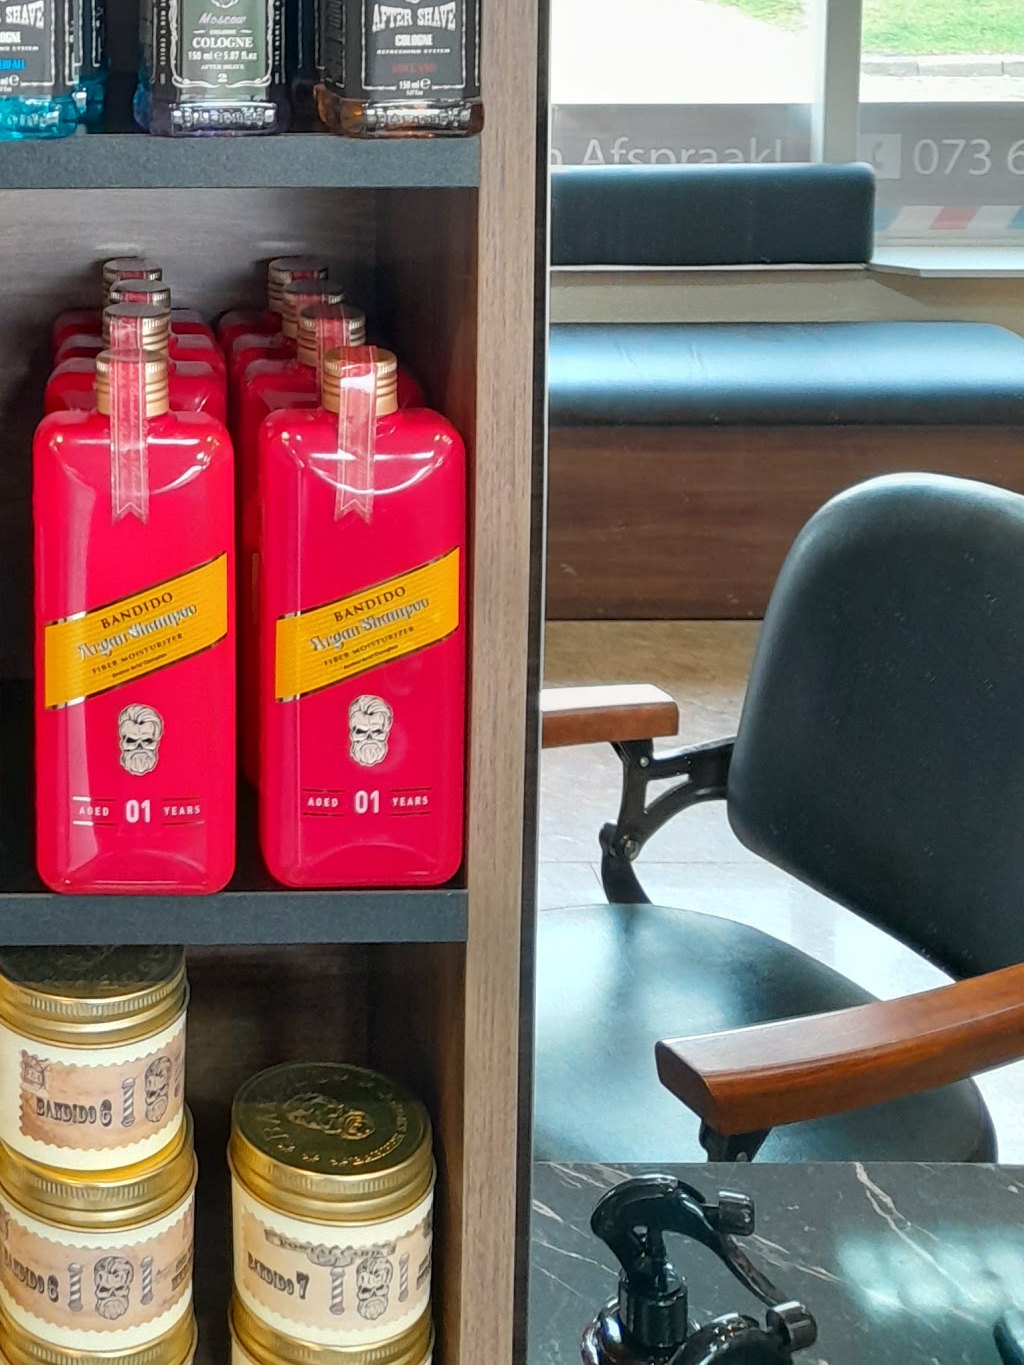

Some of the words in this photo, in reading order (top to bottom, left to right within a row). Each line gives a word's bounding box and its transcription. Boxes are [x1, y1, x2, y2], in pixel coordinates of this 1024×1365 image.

[6, 0, 45, 29] SHAVE
[372, 4, 413, 32] AFTER
[417, 1, 456, 31] SHAVE
[192, 37, 254, 48] COLOGNE
[395, 34, 433, 46] COLOGNE
[203, 51, 213, 60] ml
[217, 73, 228, 83] 2
[399, 80, 411, 90] 150
[913, 138, 992, 176] 073
[101, 592, 173, 629] BANDIDO
[334, 586, 406, 622] BANDIDO
[92, 660, 117, 674] FIBER
[324, 651, 349, 666] FIBER
[79, 806, 109, 817] AGED
[126, 799, 151, 823] 01
[163, 804, 201, 816] YEARS
[308, 796, 339, 808] AGED
[354, 790, 380, 814] 01
[392, 795, 428, 807] YEARS
[36, 1096, 97, 1125] BANDIDO
[296, 1271, 309, 1300] 7
